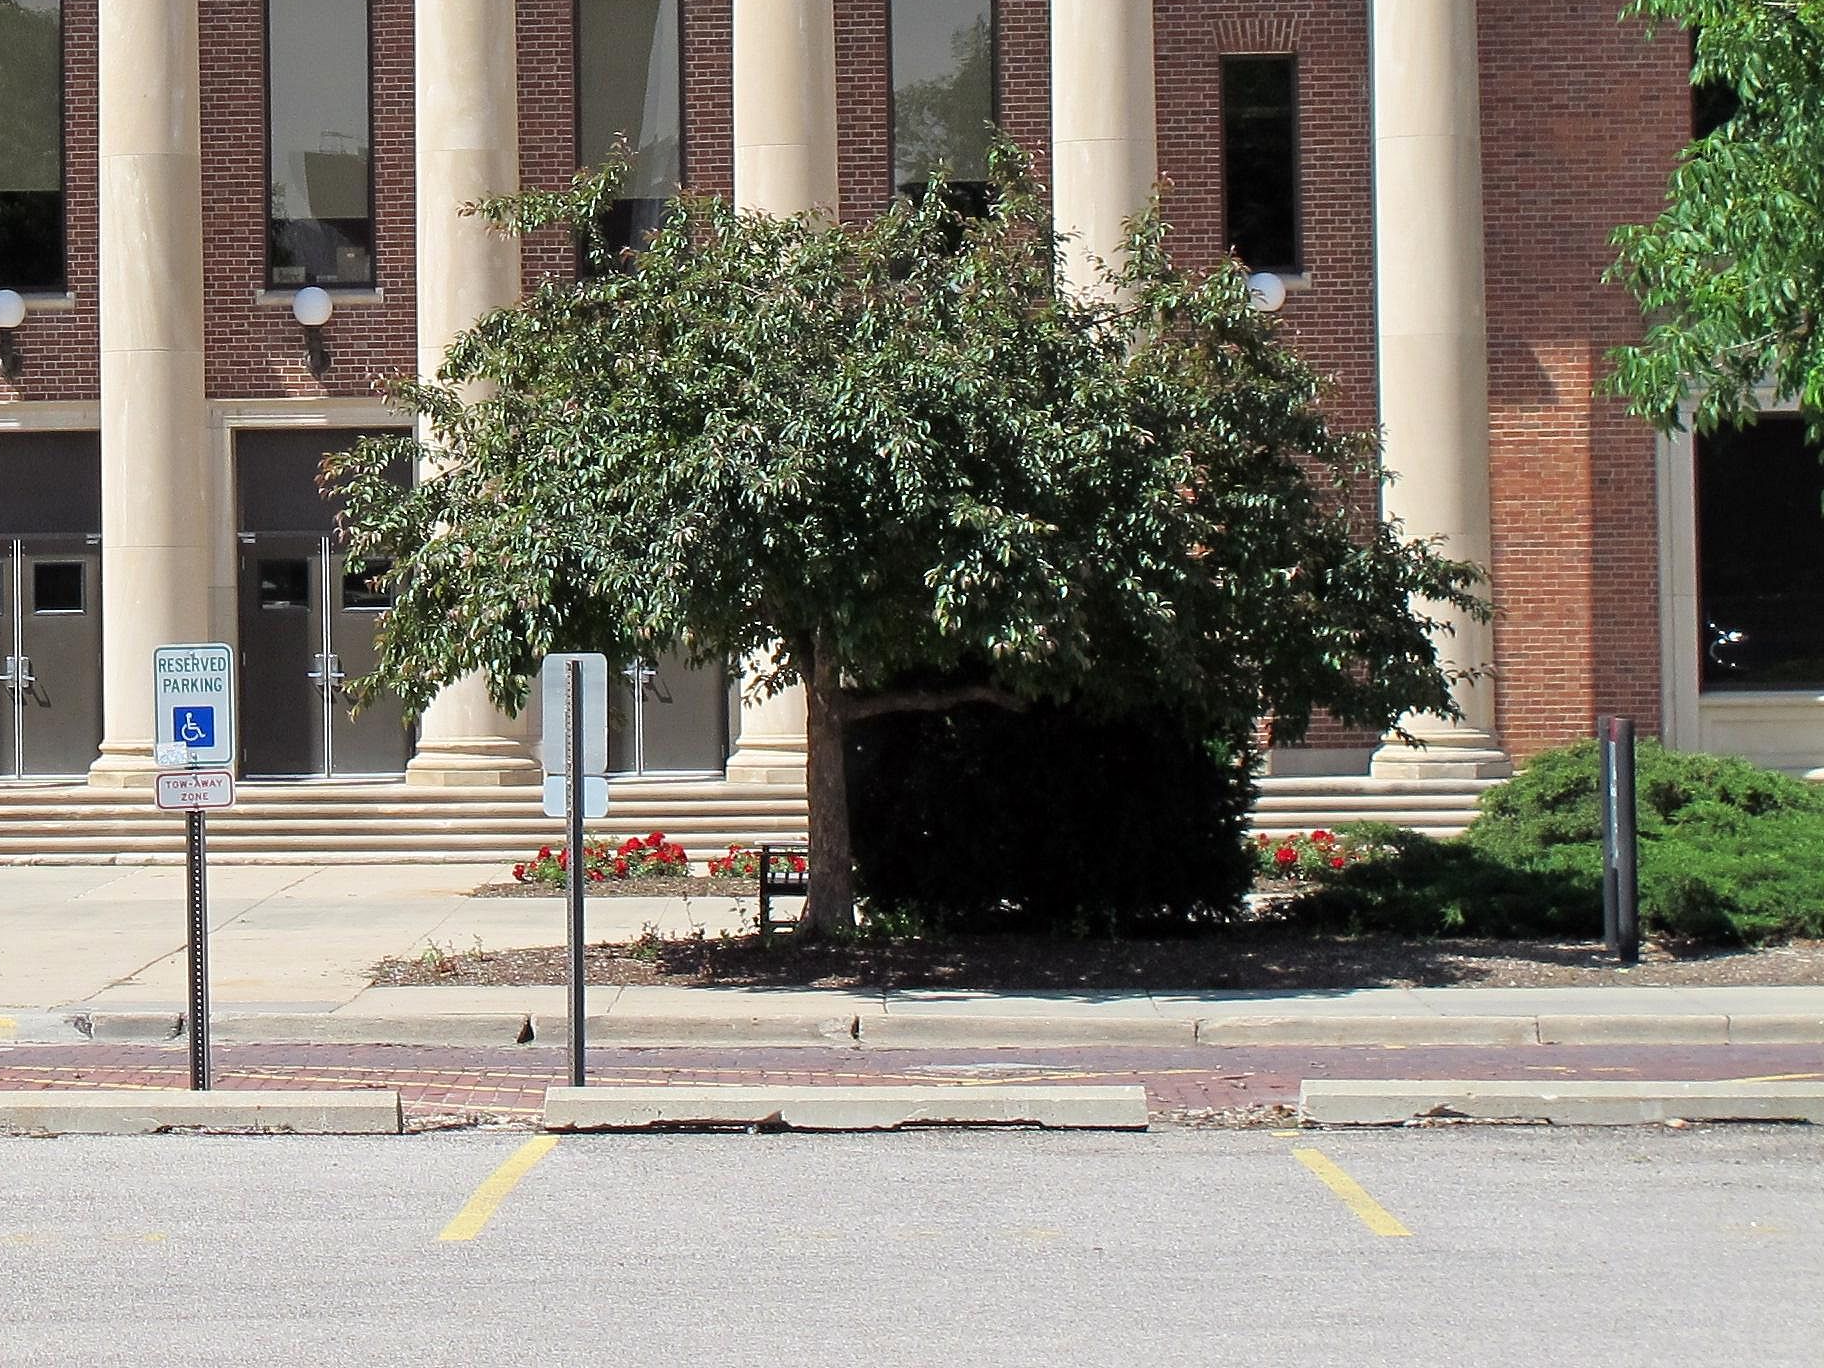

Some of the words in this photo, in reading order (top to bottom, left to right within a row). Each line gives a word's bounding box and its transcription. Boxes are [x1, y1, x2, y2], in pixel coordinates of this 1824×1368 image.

[158, 656, 227, 673] RESERVED
[163, 677, 223, 693] PARKING
[165, 779, 223, 789] TOW-AWAY
[181, 792, 209, 801] ZONE
